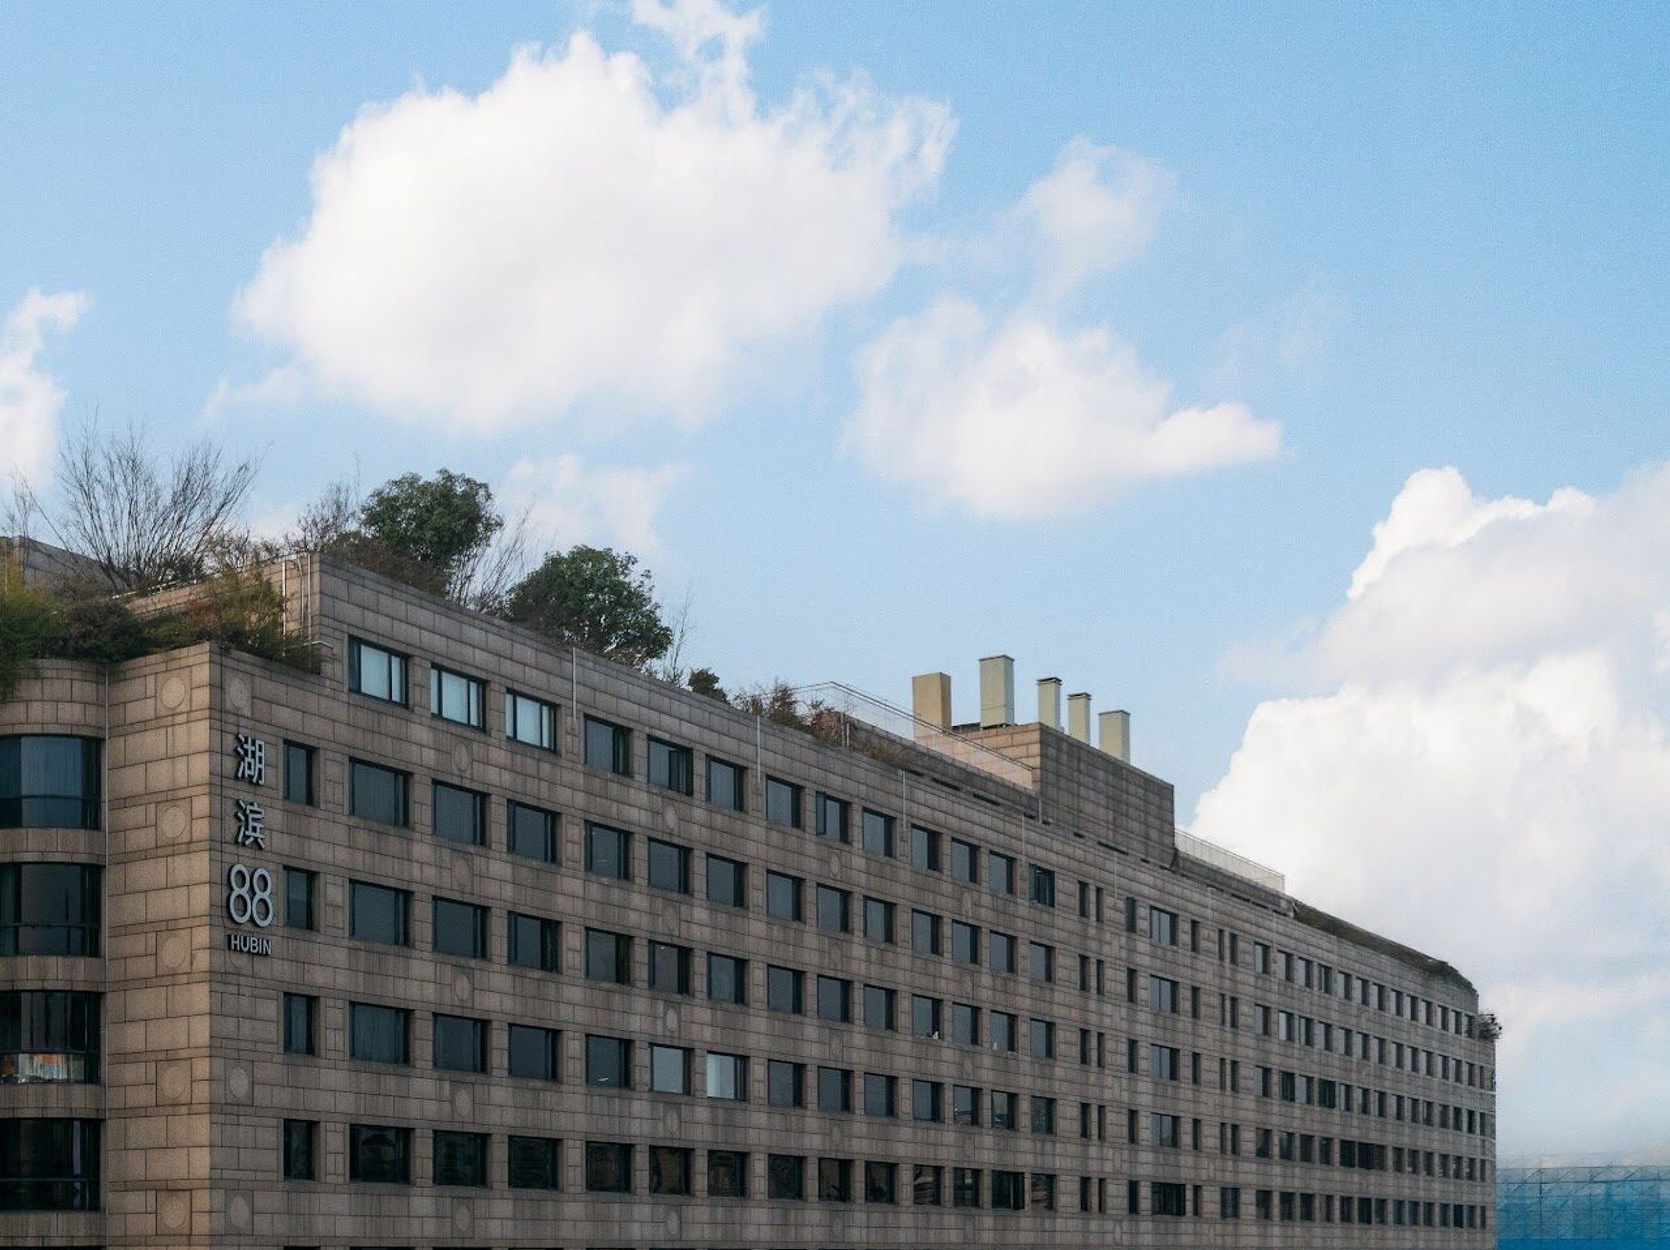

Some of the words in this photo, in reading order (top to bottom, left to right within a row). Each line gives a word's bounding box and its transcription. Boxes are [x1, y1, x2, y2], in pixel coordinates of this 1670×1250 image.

[235, 734, 267, 850] 湖滨
[229, 863, 274, 928] 88
[229, 934, 273, 956] HUBIN
